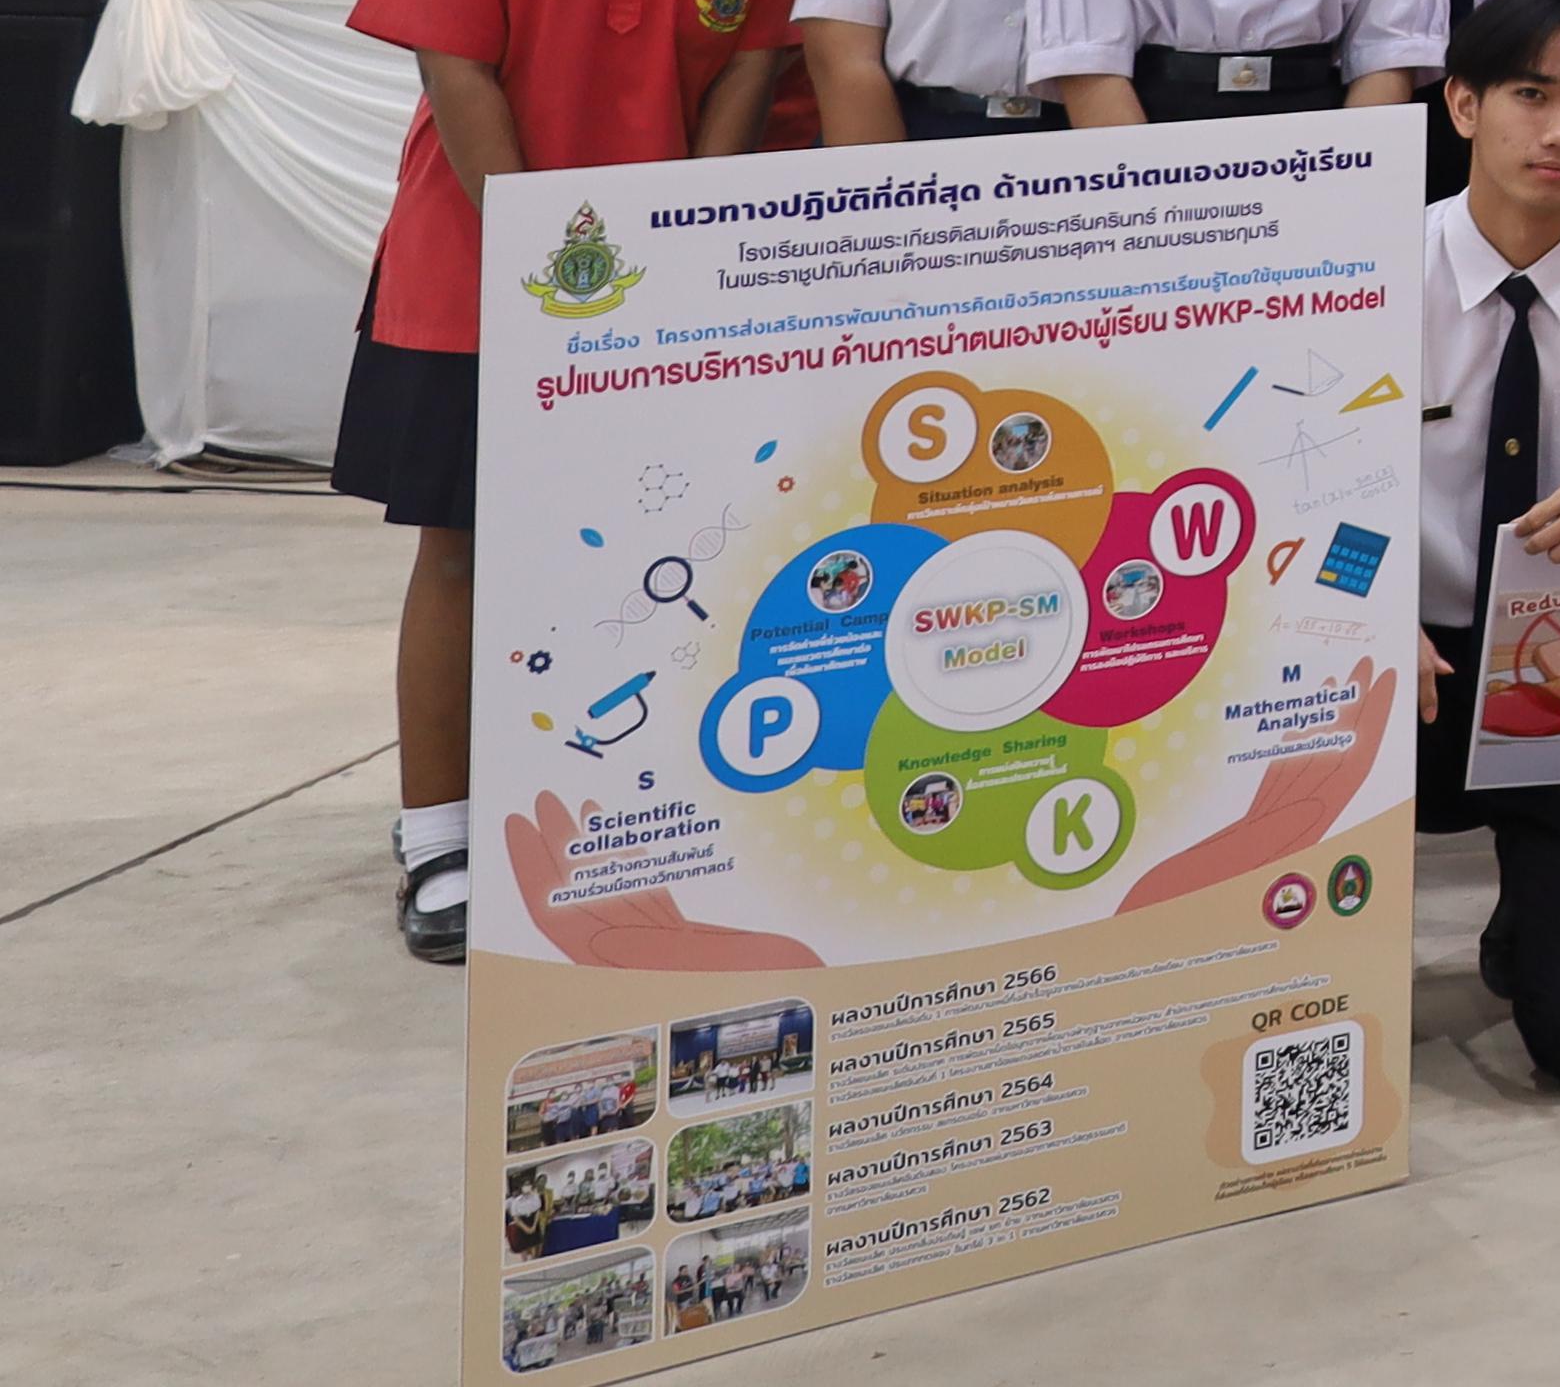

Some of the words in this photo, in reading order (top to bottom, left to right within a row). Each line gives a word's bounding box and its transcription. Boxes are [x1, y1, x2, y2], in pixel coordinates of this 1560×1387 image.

[651, 168, 980, 236] แนวทางปฏิบัติที่ดีที่สุด
[994, 143, 1372, 207] ด้านการนำตนเองของผู้เรียน
[1164, 199, 1262, 224] กำแพงเพชร
[1123, 220, 1279, 254] สยามบรมราชกุมารี
[536, 339, 823, 411] รูปแบบการบริหารงาน
[832, 302, 1166, 377] ด้านการนำตนเองของผู้เรียน
[1175, 291, 1303, 330] SWKP-SM
[1311, 283, 1384, 315] Model
[567, 325, 639, 356] ชื่อเรื่อง
[907, 404, 947, 461] S
[918, 485, 992, 505] Situation
[1000, 475, 1064, 497] analysis
[1170, 499, 1225, 561] W
[751, 618, 829, 641] Potential
[840, 610, 889, 629] Camp
[914, 592, 1060, 633] SWKP-SM
[1098, 620, 1186, 642] Workshops
[943, 637, 1026, 671] Model
[1282, 664, 1301, 684] M
[1225, 686, 1356, 720] Mathematical
[1257, 706, 1336, 733] Analysis
[749, 695, 793, 759] P
[898, 745, 992, 772] Knowledge
[1002, 732, 1068, 755] Sharing
[638, 770, 656, 791] S
[588, 800, 696, 833] Scientific
[1053, 793, 1094, 857] K
[569, 817, 721, 856] collaboration
[831, 978, 996, 1027] ผลงานปีการศึกษา
[1003, 965, 1057, 990] 2566
[1252, 1007, 1282, 1032] QR
[1291, 995, 1350, 1023] CODE
[830, 1026, 994, 1075] ผลงานปีการศึกษา
[1002, 1012, 1055, 1038] 2565
[828, 1085, 993, 1138] ผลงานปีการศึกษา
[1001, 1073, 1054, 1099] 2564
[827, 1137, 992, 1187] ผลงานปีการศึกษา
[1000, 1119, 1052, 1146] 2563
[826, 1204, 991, 1256] ผลงานปีการศึกษา
[998, 1188, 1051, 1214] 2562
